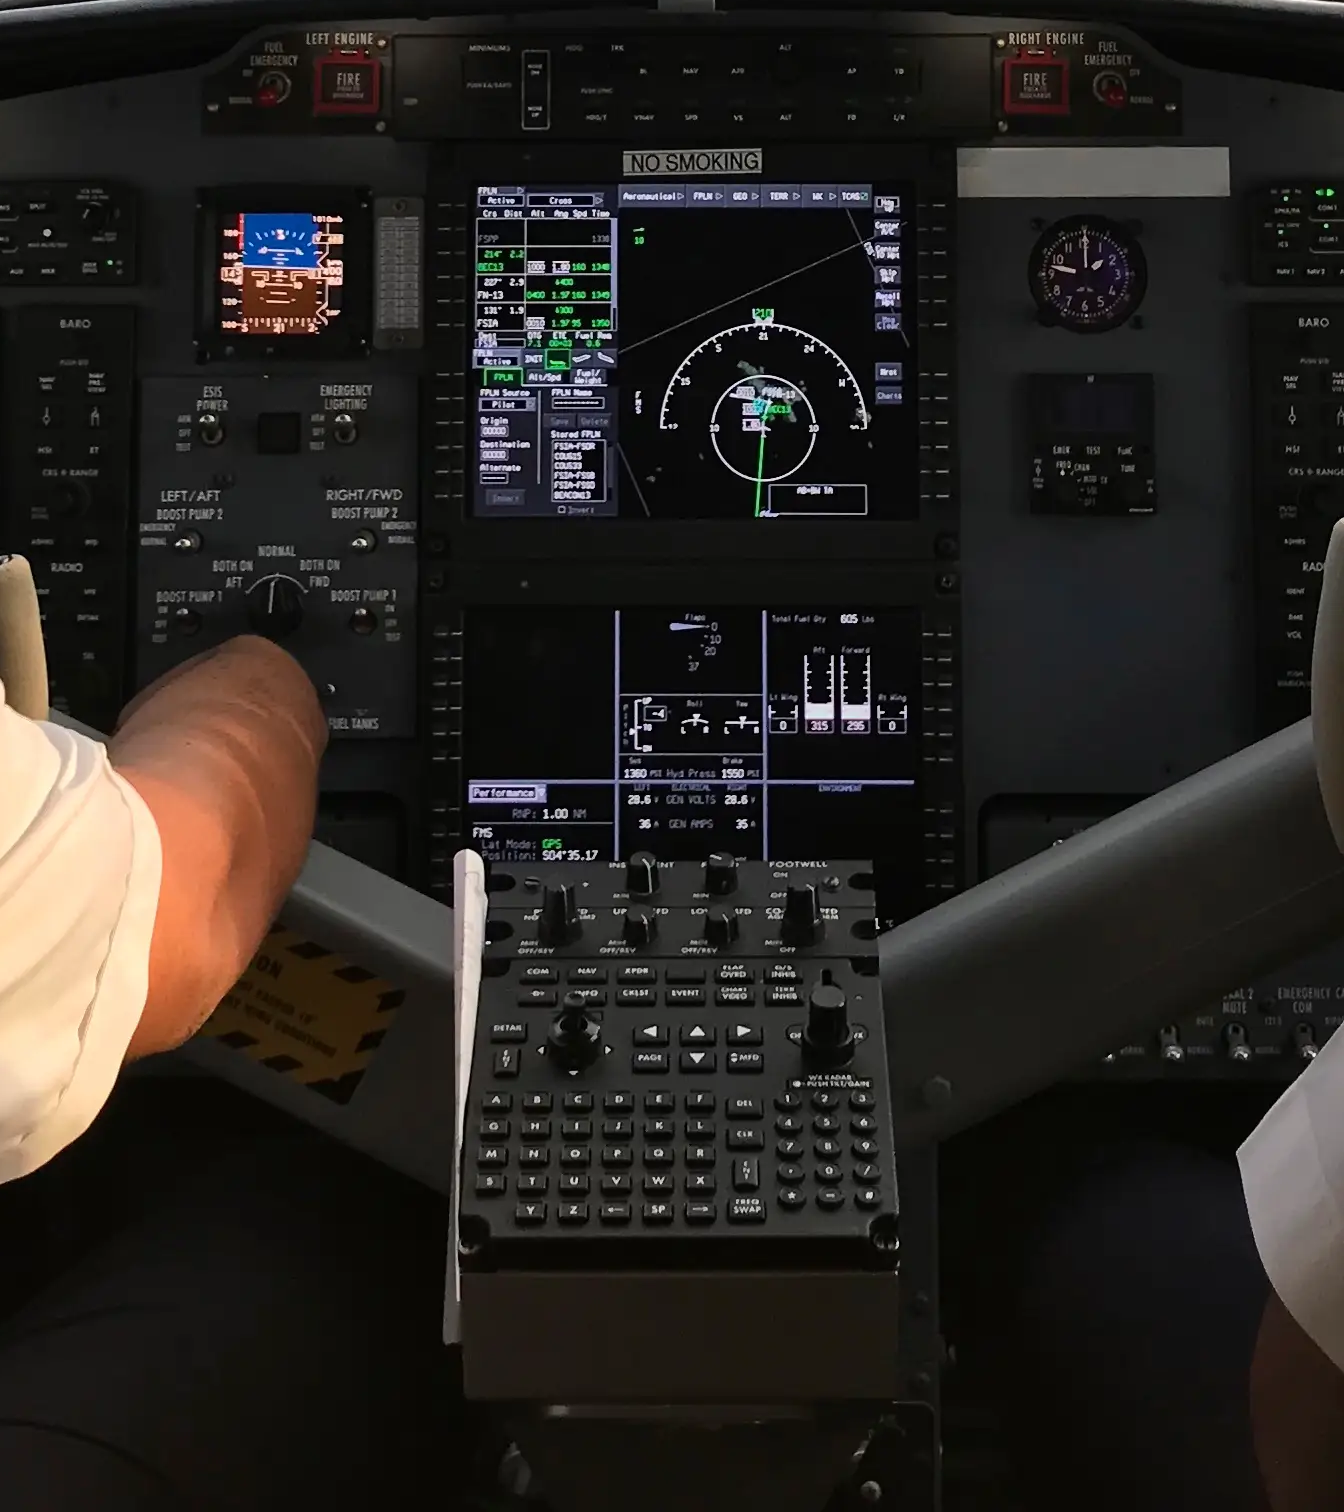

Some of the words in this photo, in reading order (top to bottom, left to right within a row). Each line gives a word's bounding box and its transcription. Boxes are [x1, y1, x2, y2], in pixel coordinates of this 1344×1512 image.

[305, 33, 329, 45] LEFT
[334, 33, 374, 45] ENGINE
[1008, 32, 1040, 45] RIGHT
[1046, 32, 1084, 45] ENGINE
[264, 42, 283, 52] FUEL
[1098, 41, 1118, 52] FUEL
[249, 55, 298, 67] EMERGENCY
[1084, 54, 1132, 66] EMERGENCY
[336, 73, 360, 86] FIRE
[1023, 73, 1047, 86] FIRE
[632, 152, 660, 172] NO
[665, 151, 759, 172] SMOKING
[487, 196, 516, 205] Active
[549, 196, 573, 205] Cross
[623, 192, 676, 201] Aeronautical
[693, 192, 713, 201] FPLN
[732, 192, 747, 201] GEO
[770, 192, 788, 201] TERR
[1051, 254, 1063, 265] 10
[1109, 255, 1116, 266] 2
[1047, 269, 1055, 280] 9
[1115, 269, 1122, 280] 3
[477, 291, 503, 299] FN-13
[1053, 285, 1060, 296] 8
[1108, 285, 1116, 296] 4
[1081, 301, 1088, 312] 6
[1096, 296, 1104, 307] 5
[59, 319, 91, 329] BARO
[477, 319, 499, 328] FSIA
[1298, 318, 1330, 328] BARO
[758, 332, 768, 340] 21
[803, 344, 814, 353] 24
[203, 386, 222, 397] ESIS
[320, 384, 372, 396] EMERGENCY
[479, 389, 500, 397] FPLN
[196, 399, 228, 411] POWER
[324, 398, 367, 410] LIGHTING
[491, 400, 515, 408] Pilot
[479, 417, 508, 426] Origin
[709, 424, 719, 432] 10
[808, 424, 819, 432] 10
[550, 430, 578, 438] Stored
[580, 430, 601, 438] FPLN
[479, 440, 530, 449] Destination
[479, 464, 521, 472] Alternate
[160, 490, 220, 502] LEFT/AFT
[325, 489, 402, 501] RIGHT/FWD
[156, 508, 186, 520] BOOST
[189, 508, 214, 520] PUMP
[216, 508, 223, 519] 2
[331, 507, 360, 519] BOOST
[363, 507, 389, 519] PUMP
[391, 507, 397, 518] 2
[257, 546, 295, 557] NORMAL
[50, 562, 83, 573] RADIO
[212, 560, 236, 572] BOTH
[239, 560, 253, 572] ON
[299, 559, 324, 571] BOTH
[327, 559, 339, 571] ON
[225, 576, 243, 588] AFT
[309, 576, 330, 588] FWD
[156, 591, 185, 602] BOOST
[189, 591, 214, 602] PUMP
[331, 590, 359, 601] BOOST
[363, 590, 388, 601] PUMP
[684, 614, 706, 623] Flaps
[840, 614, 858, 624] 605
[711, 622, 718, 631] 0
[709, 634, 722, 644] 10
[704, 646, 716, 656] 20
[688, 662, 699, 671] 37
[351, 717, 379, 730] TANKS
[779, 721, 787, 731] 0
[811, 721, 828, 731] 315
[847, 721, 865, 731] 295
[888, 721, 896, 731] 0
[666, 769, 684, 780] Hyd
[687, 769, 716, 779] Press
[472, 788, 535, 798] Performance
[627, 795, 652, 805] 28.6
[666, 795, 684, 805] GEN
[688, 795, 717, 805] VOLTS
[724, 795, 749, 805] 28.6
[542, 808, 568, 819] 1.00
[690, 819, 714, 829] AMPS
[472, 827, 493, 838] FMS
[481, 839, 501, 849] Lat
[541, 839, 563, 849] GPS
[526, 967, 549, 975] COM
[671, 989, 699, 997] EVENT
[721, 992, 748, 1000] VIDEO
[1277, 987, 1332, 1000] EMERGENCY
[1222, 1002, 1248, 1014] MUTE
[493, 1024, 522, 1032] DETAIL
[491, 1095, 501, 1104] A
[574, 1095, 582, 1104] C
[614, 1095, 623, 1104] D
[530, 1122, 540, 1130] H
[485, 1150, 497, 1158] M
[529, 1149, 538, 1158] N
[570, 1149, 580, 1158] O
[569, 1176, 579, 1185] U
[611, 1176, 621, 1185] V
[651, 1176, 665, 1185] W
[696, 1176, 705, 1184] X
[526, 1205, 535, 1215] Y
[569, 1205, 577, 1214] Z
[651, 1205, 665, 1214] SP
[733, 1205, 762, 1214] SWAP
